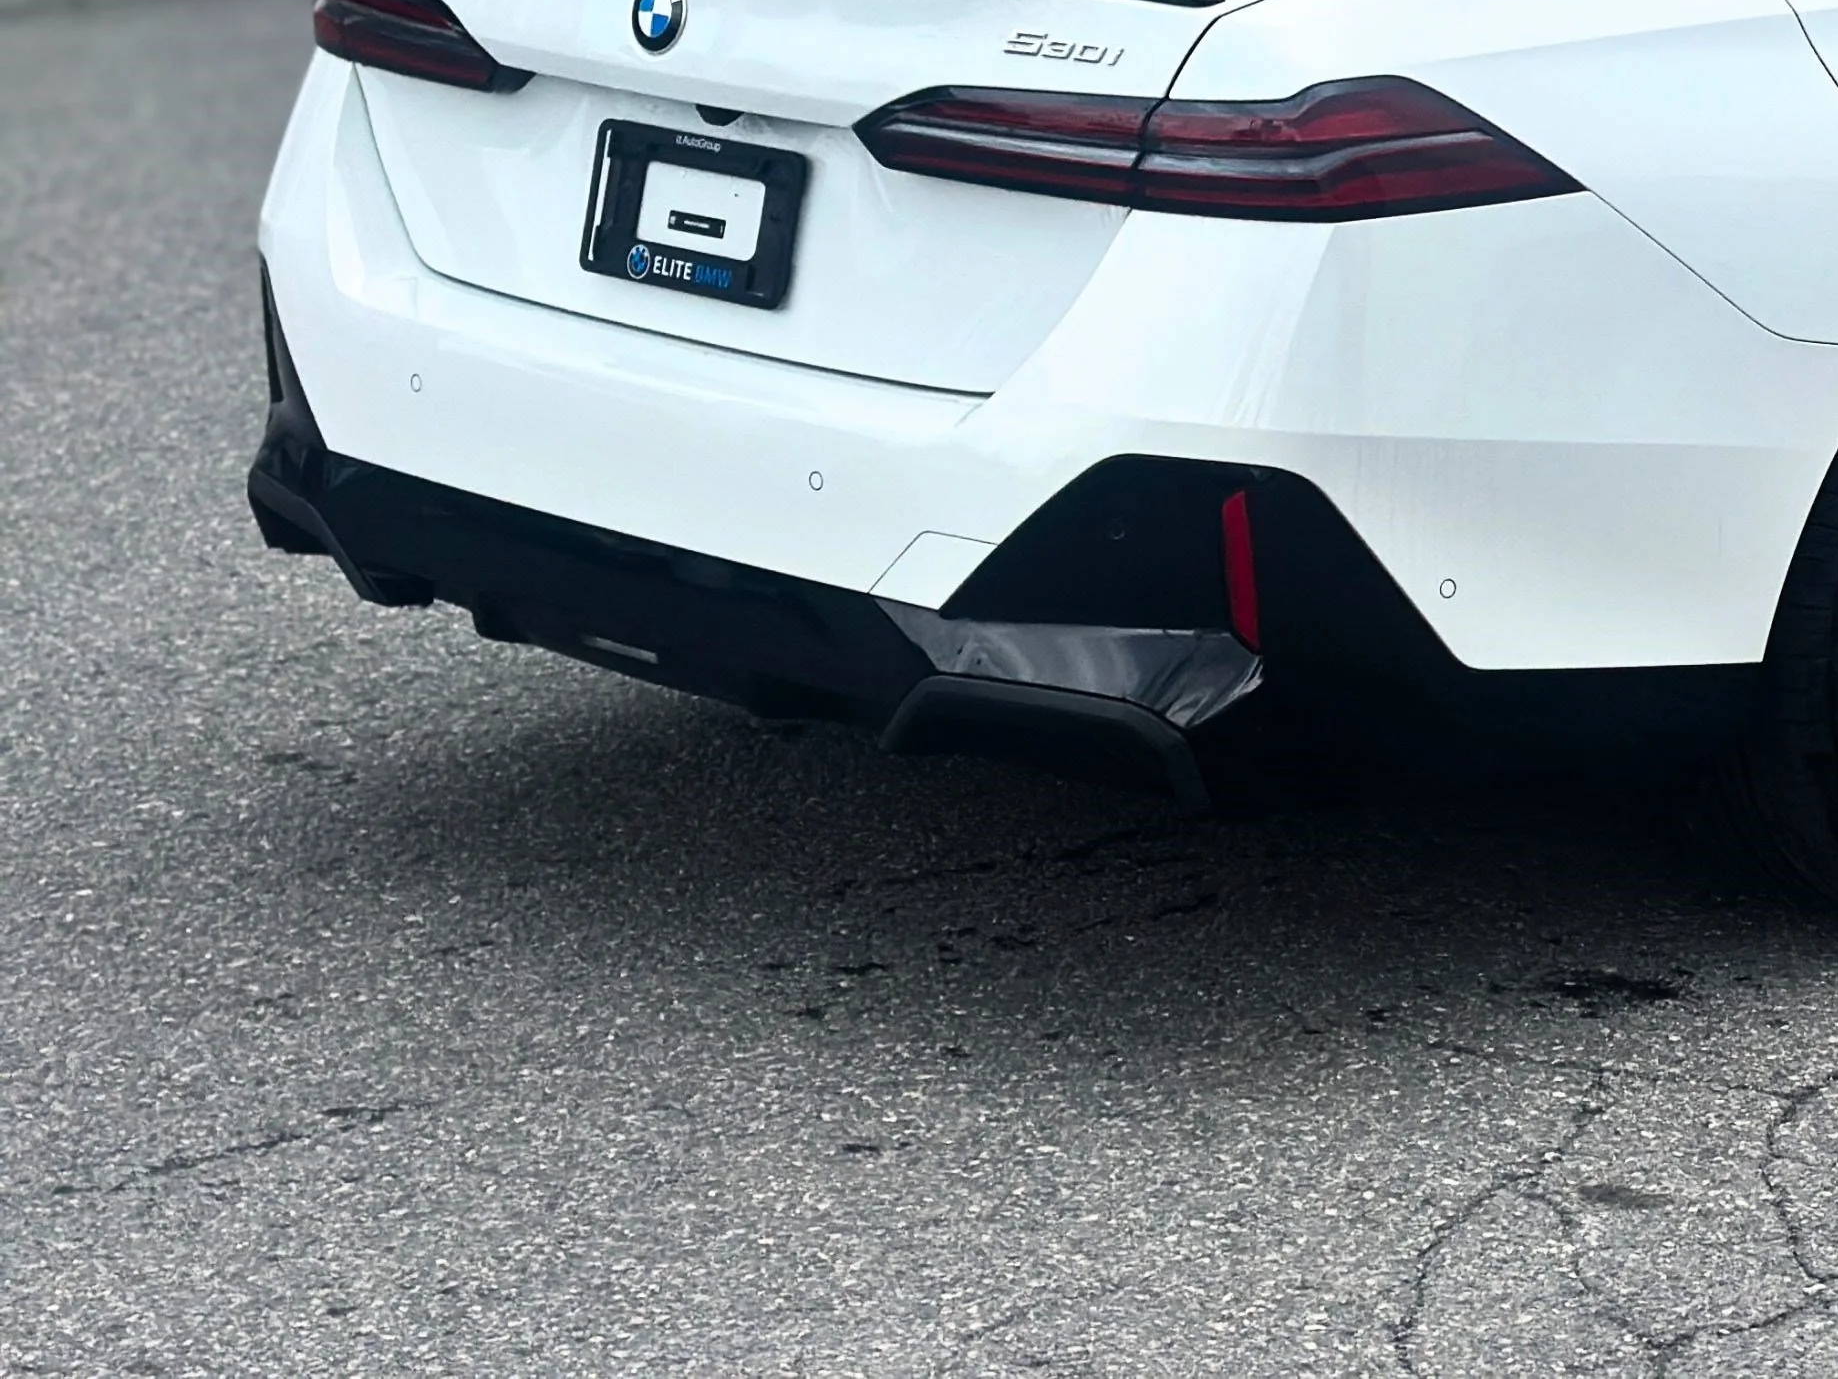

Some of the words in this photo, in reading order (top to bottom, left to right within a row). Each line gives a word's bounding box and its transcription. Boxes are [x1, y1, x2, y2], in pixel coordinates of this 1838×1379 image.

[1003, 30, 1125, 67] 530i
[652, 255, 693, 281] ELITE
[694, 264, 732, 288] BMW
